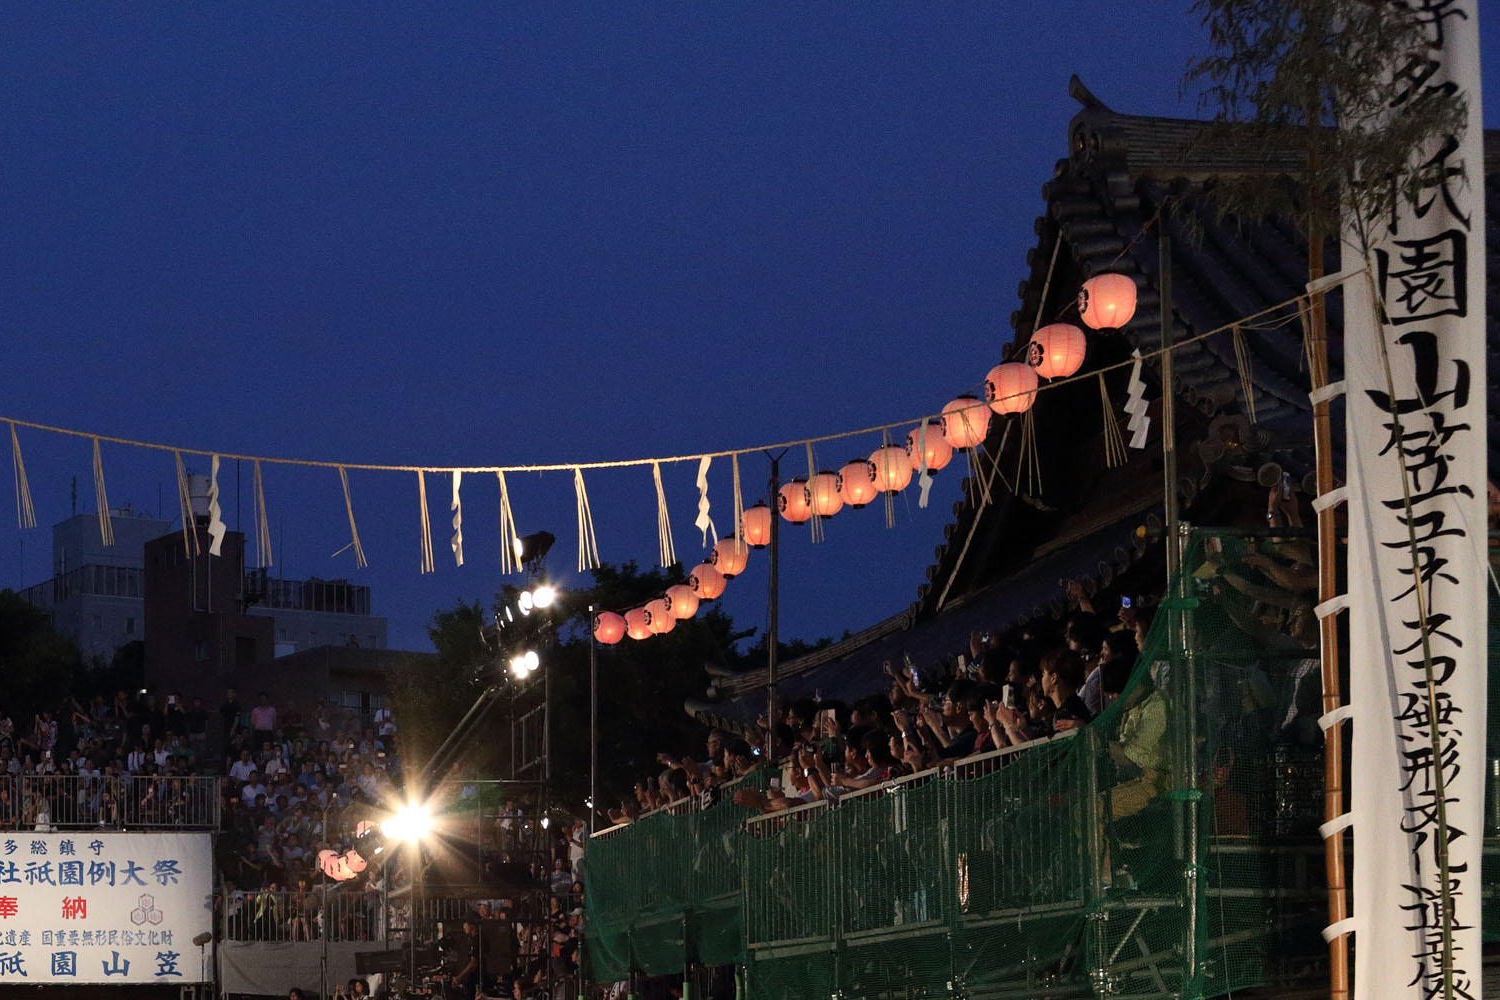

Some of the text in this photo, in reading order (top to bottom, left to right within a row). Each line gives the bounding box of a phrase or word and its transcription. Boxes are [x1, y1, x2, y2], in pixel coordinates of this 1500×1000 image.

[41, 929, 173, 946] 国重要無形民俗文化財
